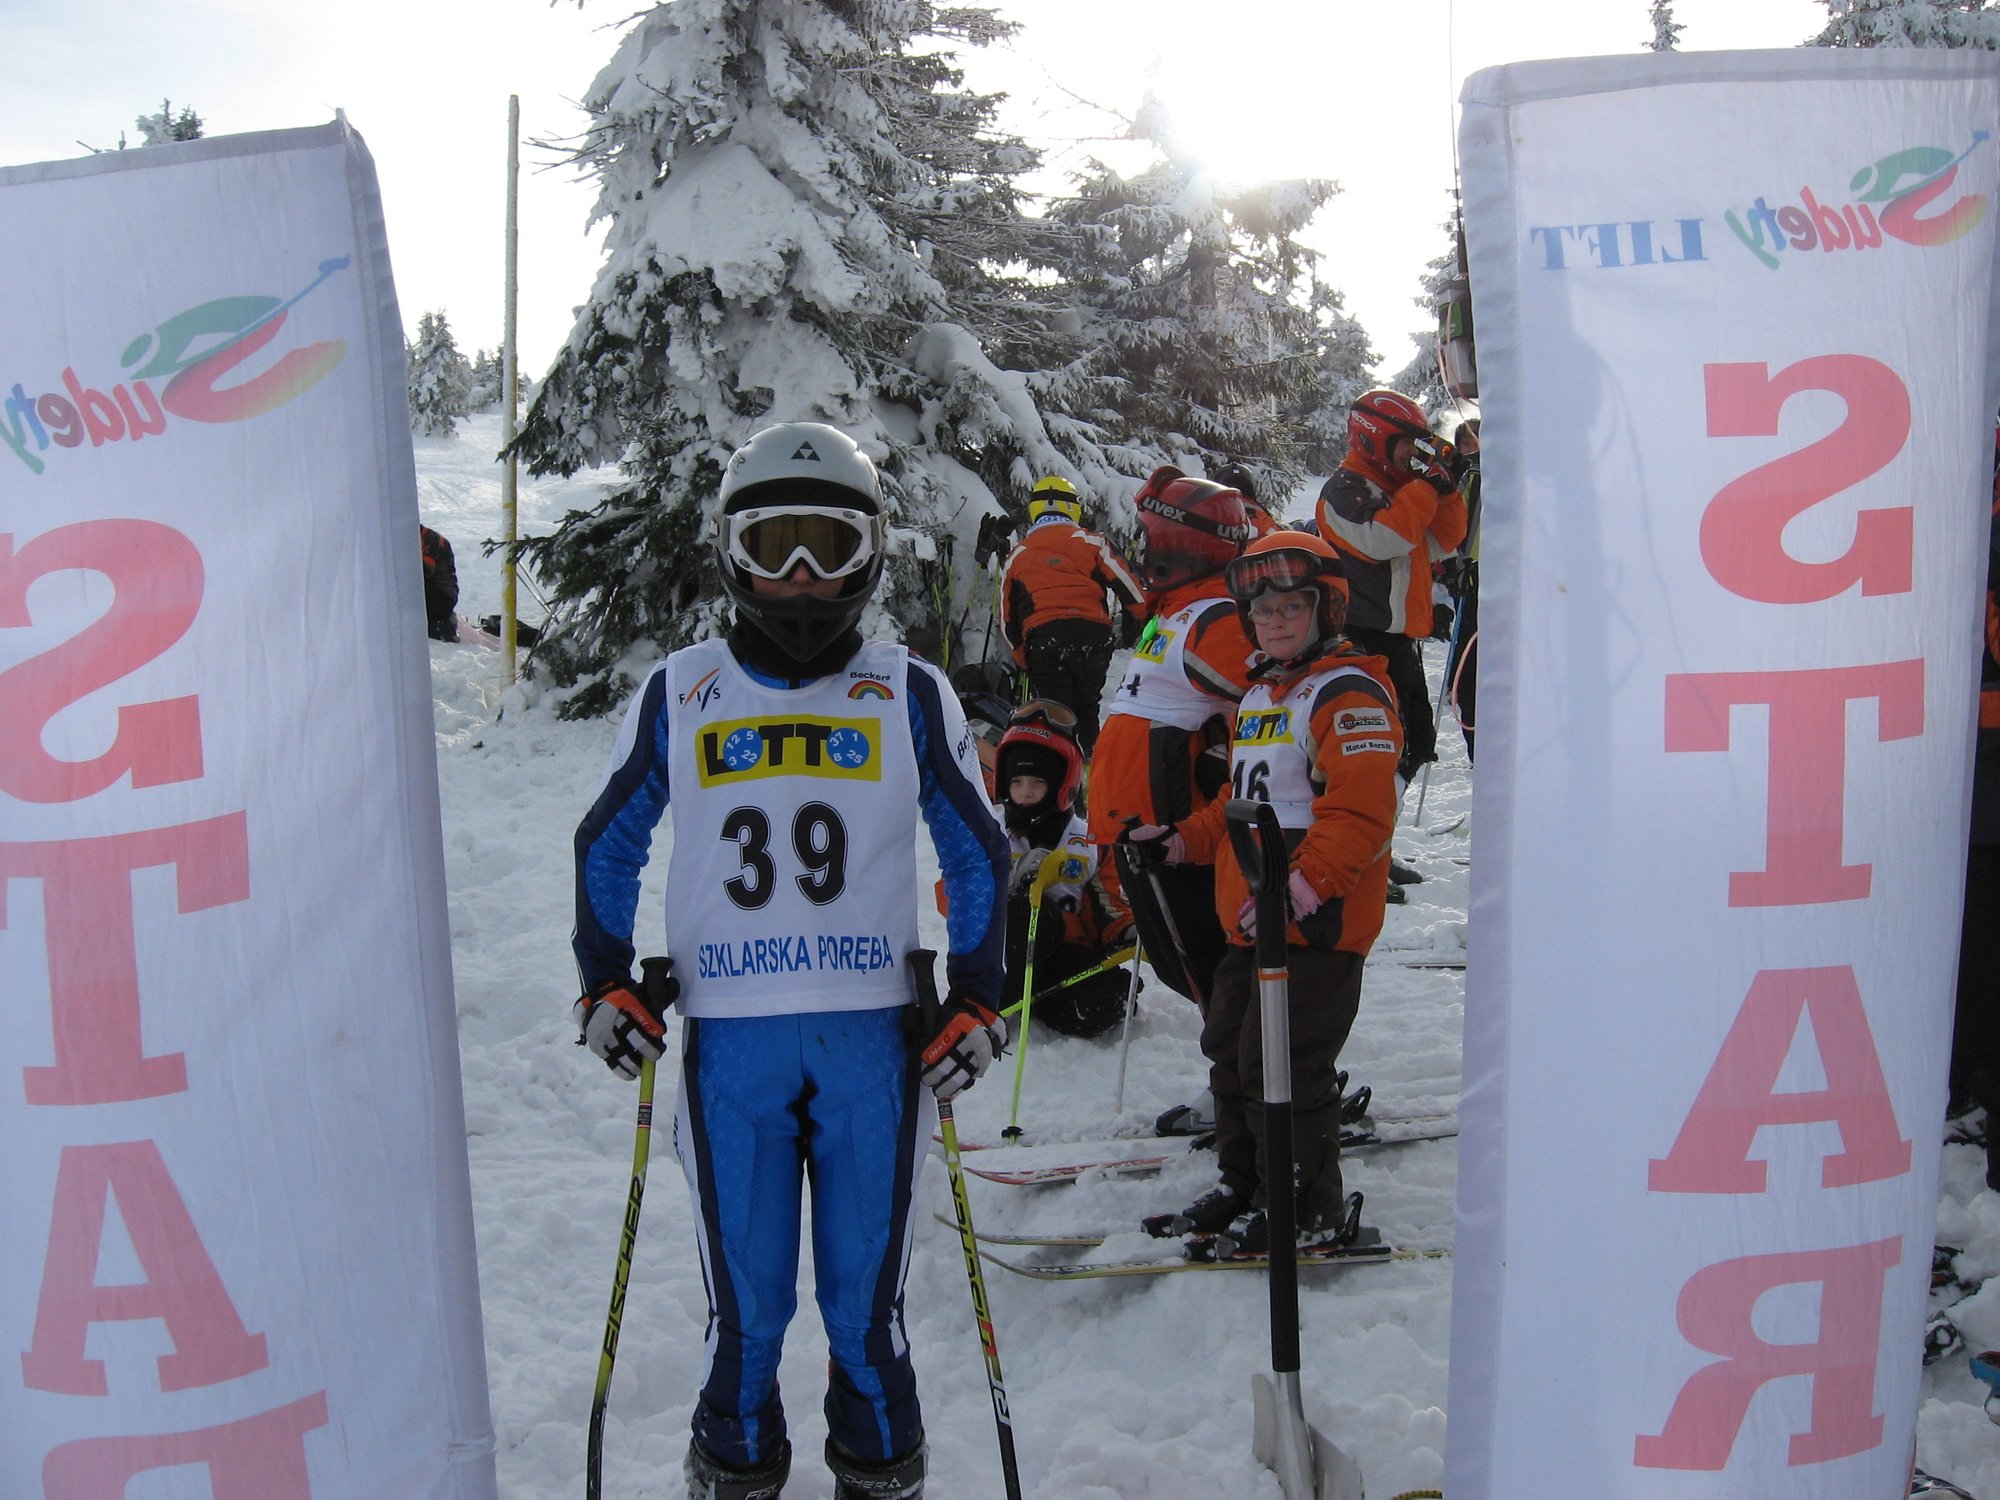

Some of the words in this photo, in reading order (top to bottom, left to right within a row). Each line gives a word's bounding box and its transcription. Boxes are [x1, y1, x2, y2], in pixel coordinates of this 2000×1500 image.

[1142, 495, 1187, 523] uvex
[850, 671, 891, 681] Beckers
[702, 723, 870, 777] LOTTO
[1345, 742, 1367, 753] Hotel
[1232, 758, 1271, 803] 16
[719, 801, 849, 911] 39
[698, 936, 812, 979] SZKLARSKA
[817, 934, 895, 975] PORĘBA
[604, 1175, 642, 1361] FISCHER
